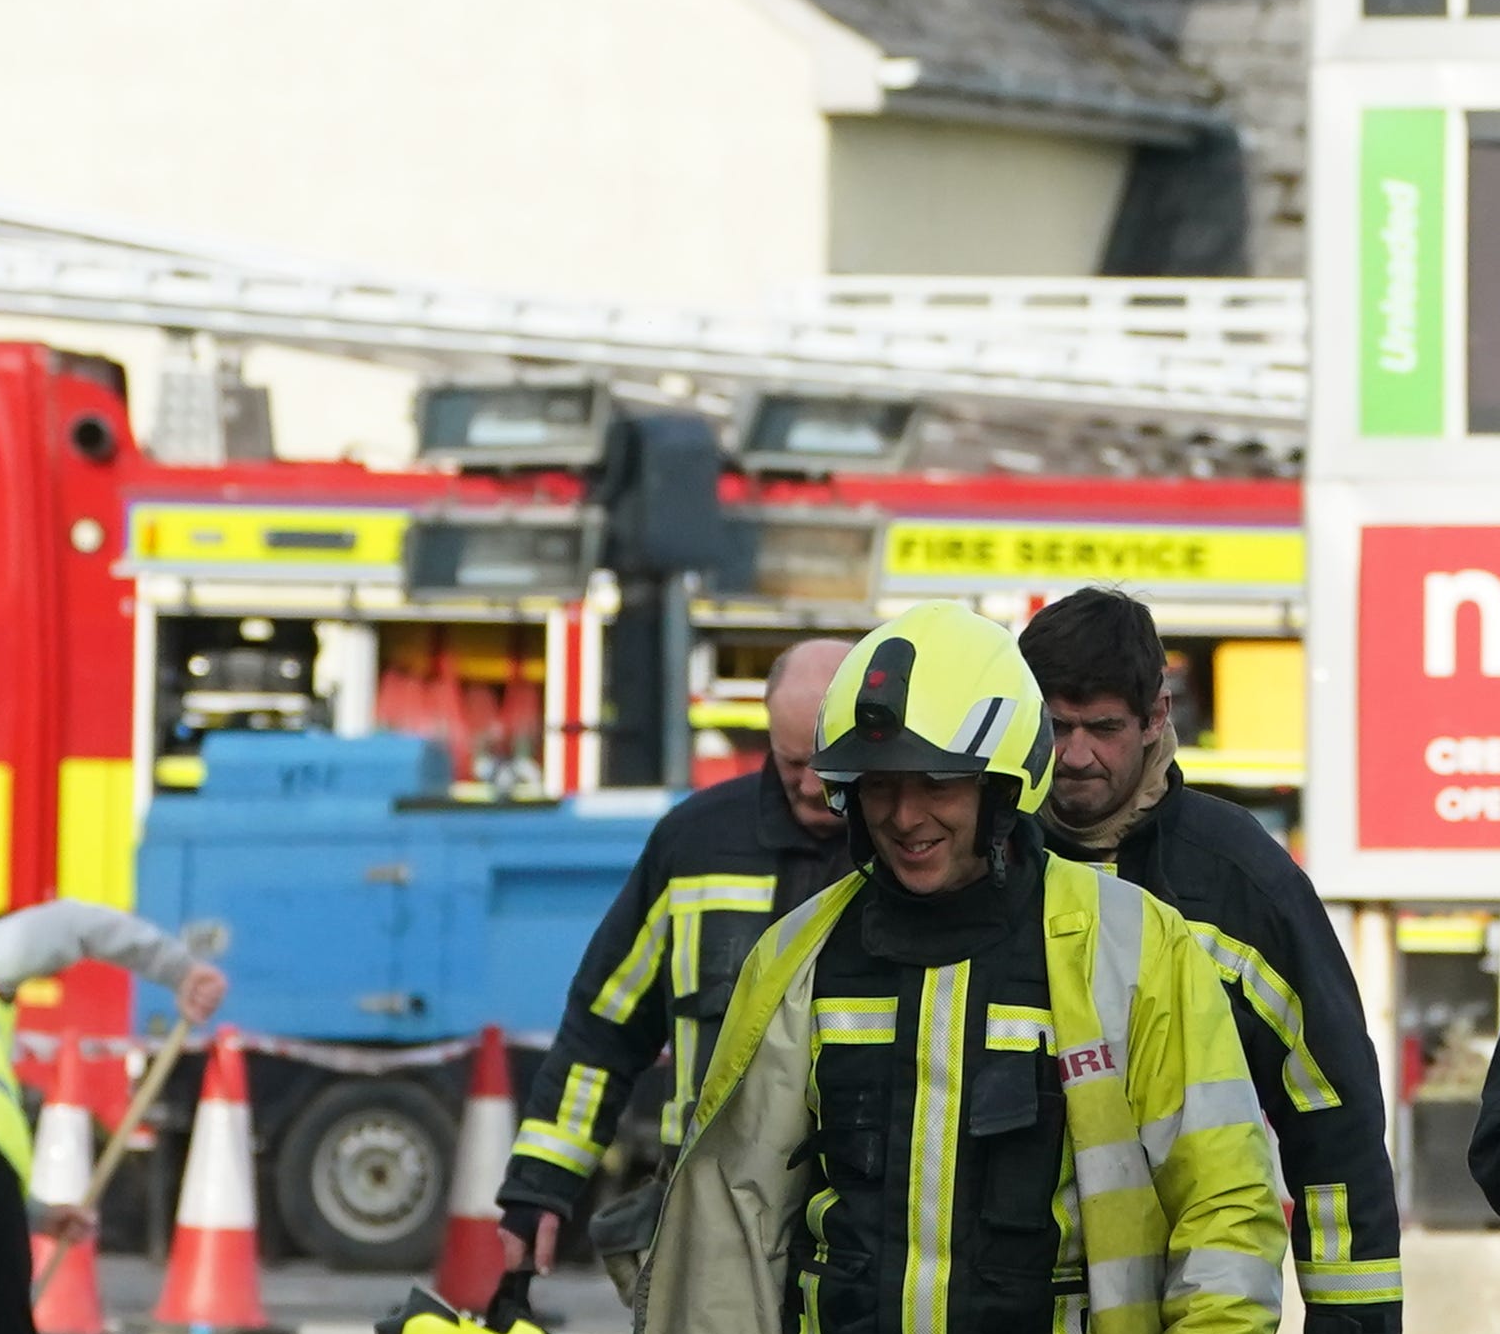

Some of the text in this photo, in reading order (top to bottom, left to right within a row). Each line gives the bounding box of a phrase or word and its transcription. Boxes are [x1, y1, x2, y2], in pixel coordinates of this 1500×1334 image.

[1379, 179, 1421, 376] Unleaded
[896, 535, 1207, 573] FIRE SERVICE
[1058, 1043, 1116, 1083] IRE
